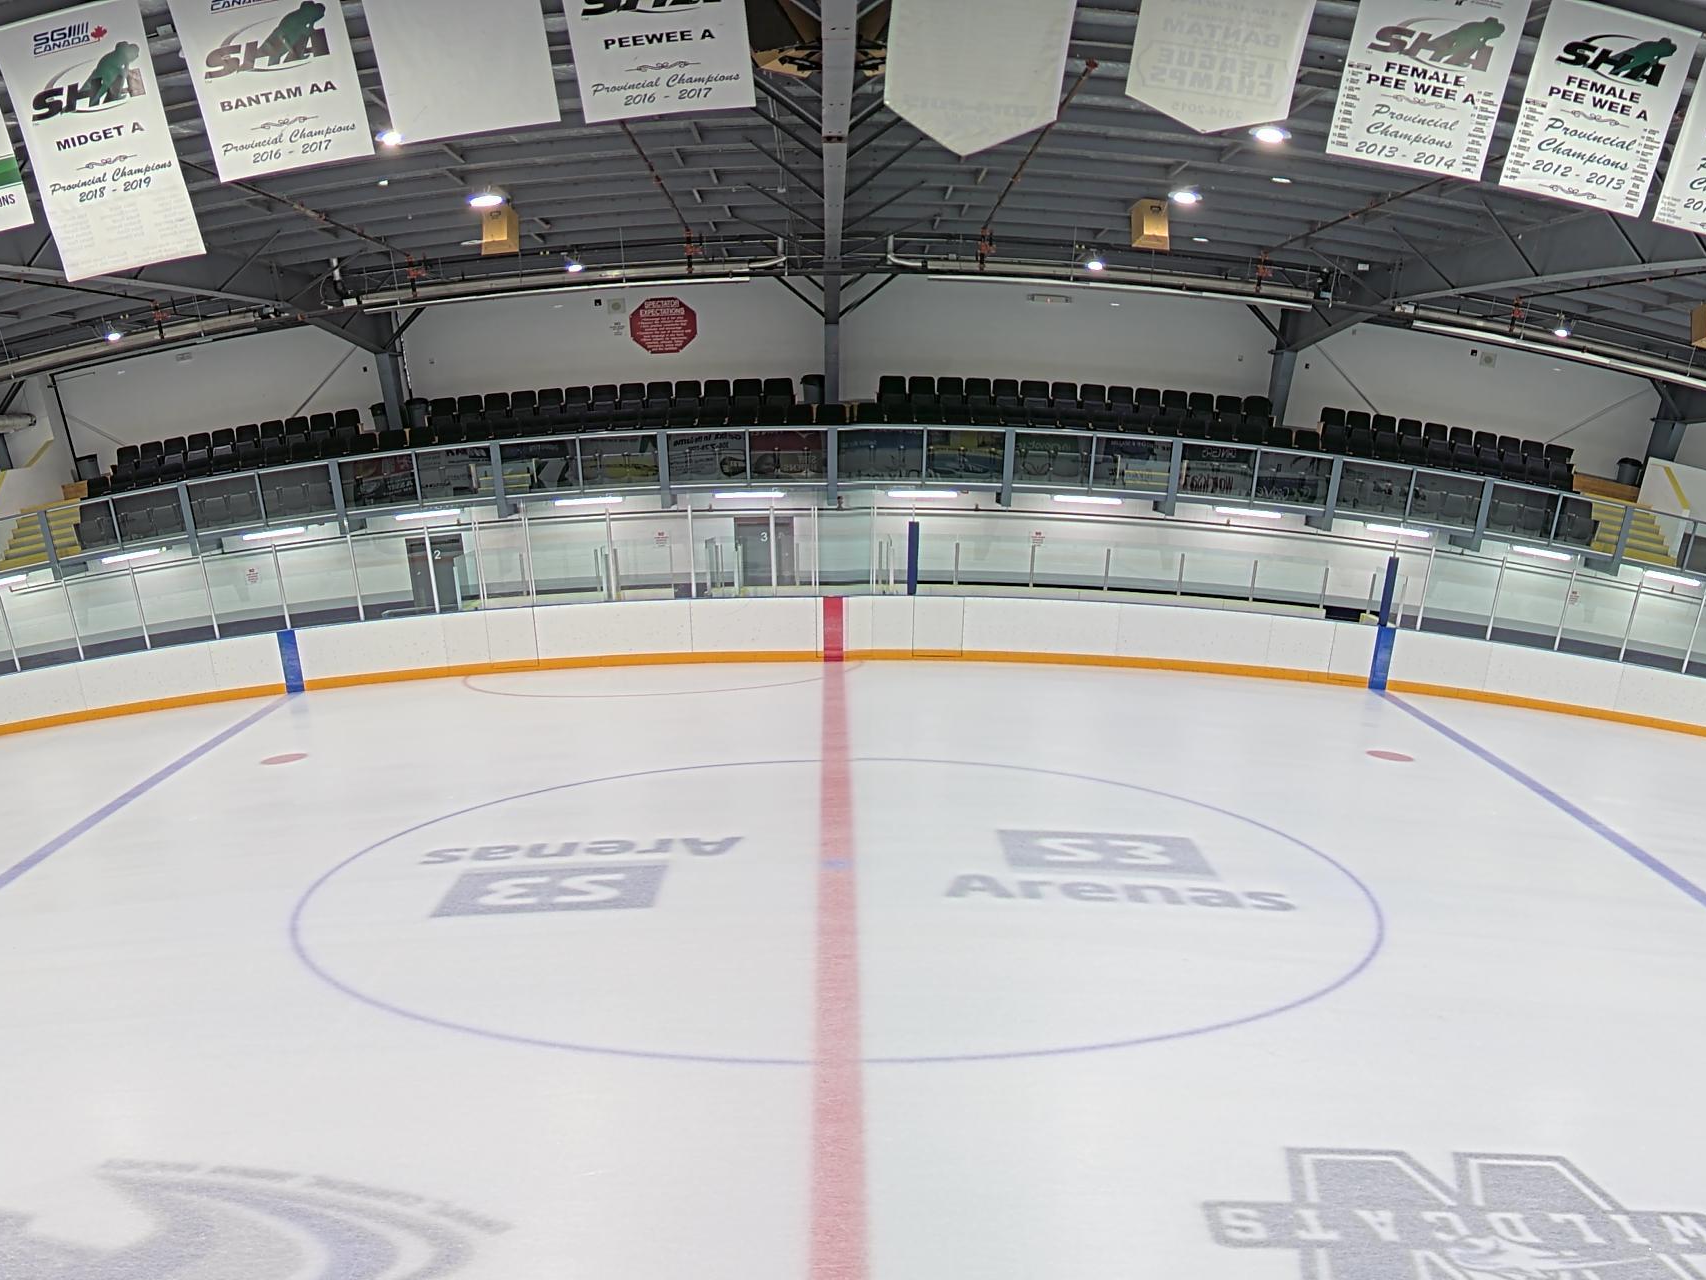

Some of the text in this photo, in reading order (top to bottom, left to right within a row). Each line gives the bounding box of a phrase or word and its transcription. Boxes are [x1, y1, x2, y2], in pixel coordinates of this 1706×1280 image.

[34, 34, 90, 55] CANADA
[205, 28, 330, 79] SHA
[604, 29, 715, 50] PEEWEE A
[1367, 26, 1494, 72] SHA
[1384, 61, 1467, 88] FEMALE
[1555, 41, 1667, 87] SHA
[32, 68, 146, 121] SHA
[220, 80, 338, 113] BANTAM AA
[592, 73, 741, 96] Provincial Champions
[624, 87, 712, 106] 2016 2017
[1366, 73, 1476, 105] PEE WEE A
[1566, 75, 1642, 104] FEMALE
[1372, 103, 1460, 132] Provincial
[1548, 86, 1649, 122] PEE WEE A
[55, 121, 145, 151] MIDGET A
[222, 122, 356, 156] Provincial Champions
[1366, 121, 1453, 149] Champions
[1544, 117, 1637, 151] Provincial
[253, 139, 332, 163] 2016 2017
[1355, 141, 1456, 170] 2013 2014
[1537, 137, 1629, 171] Champions
[49, 160, 172, 196] Provincial Champions
[1532, 159, 1625, 190] 2012 2013
[78, 177, 151, 203] 2018 2019
[760, 532, 768, 541] 3
[433, 550, 441, 559] 2
[416, 836, 745, 865] Arenas
[945, 873, 1297, 911] Arenas
